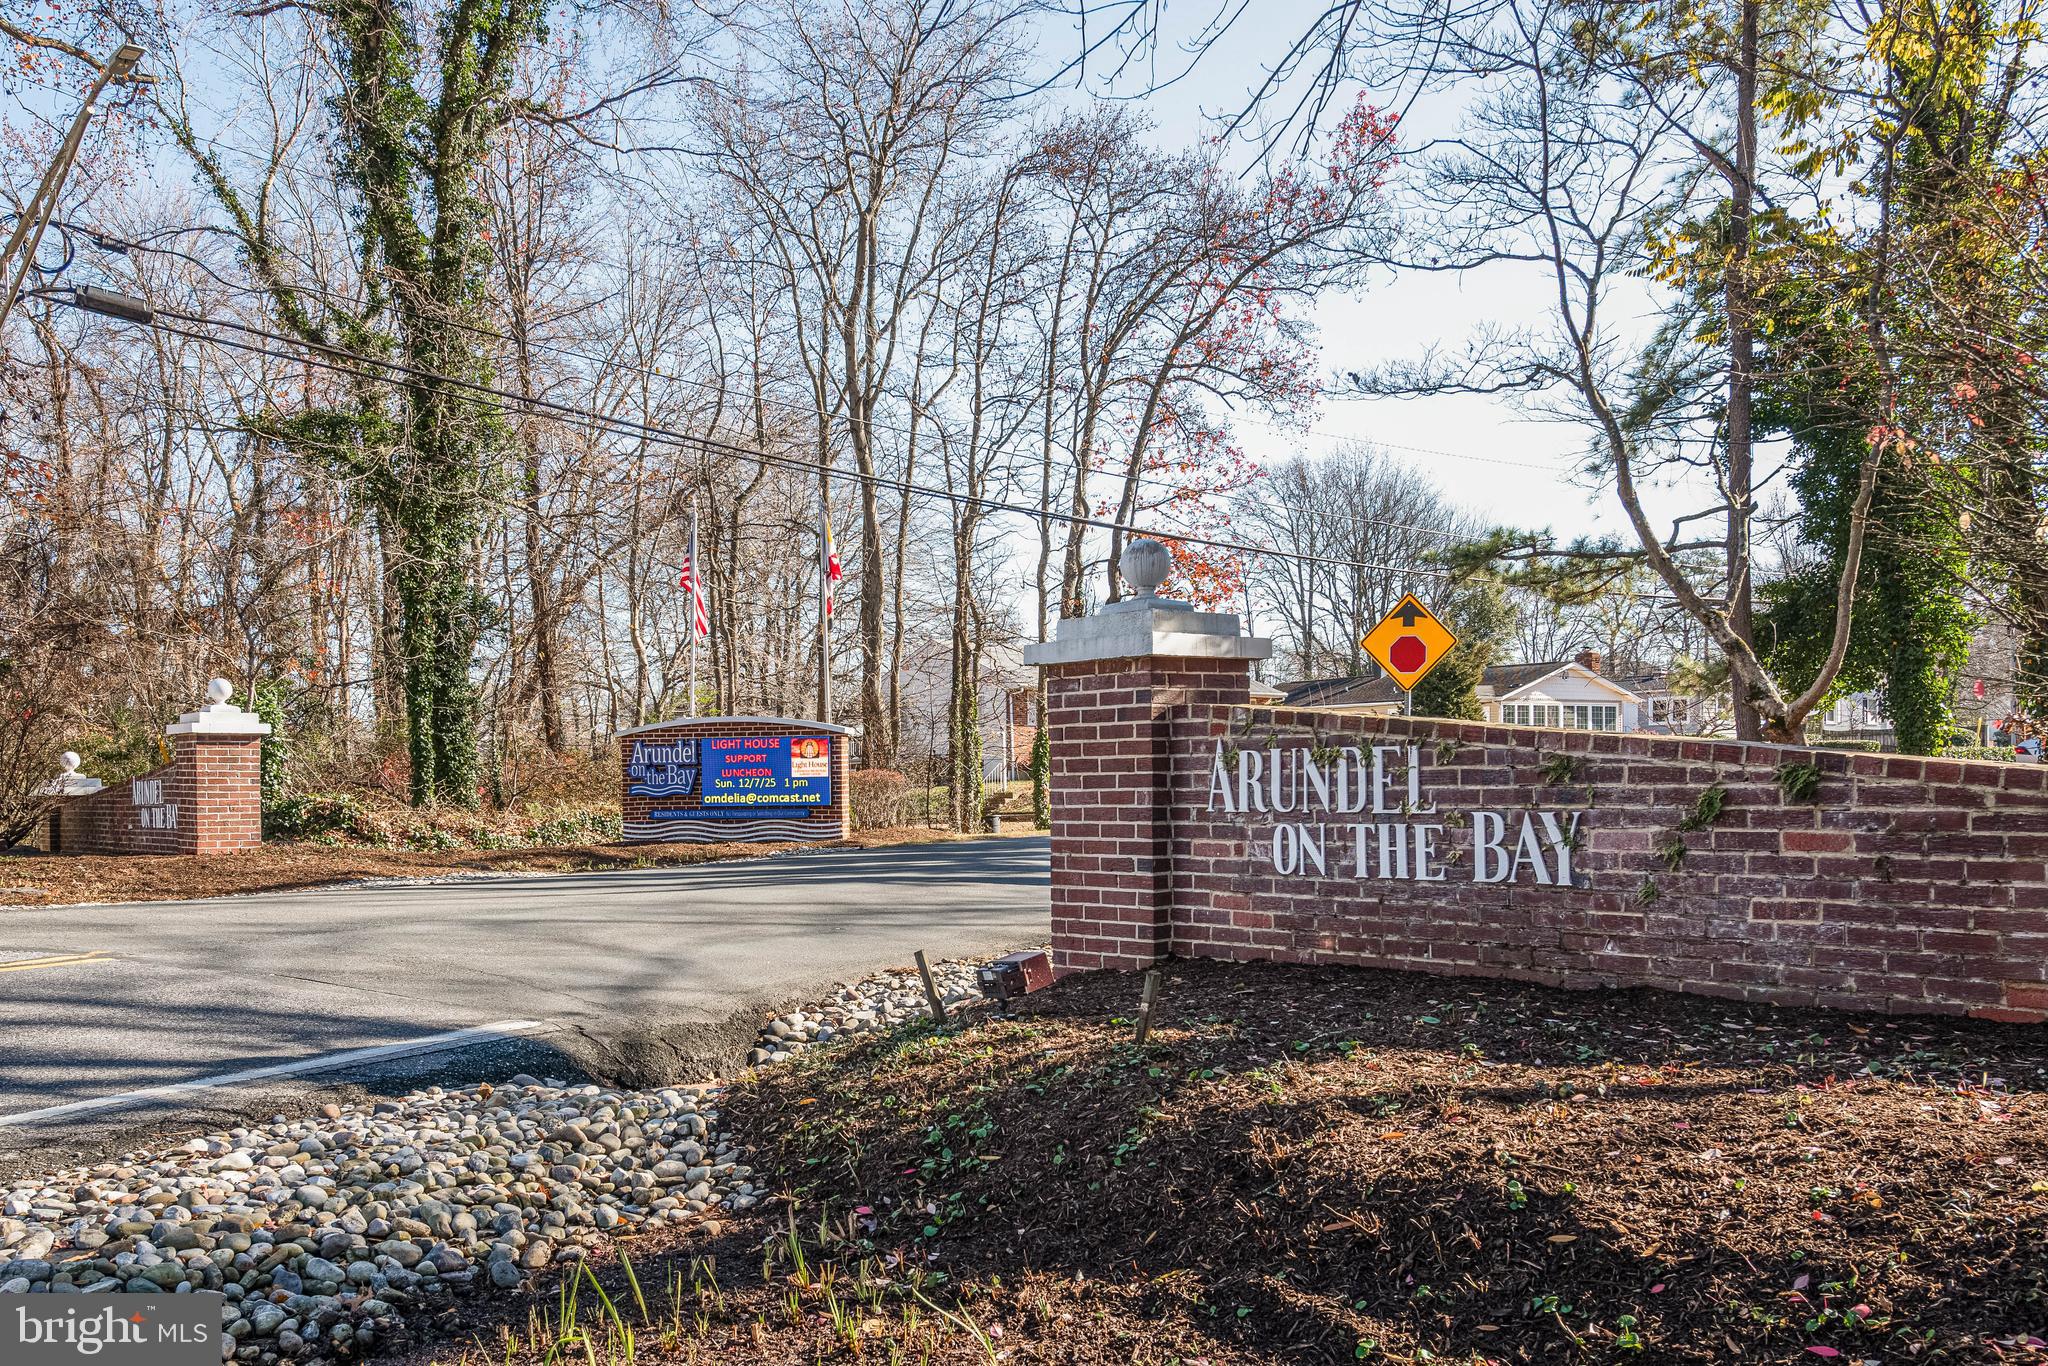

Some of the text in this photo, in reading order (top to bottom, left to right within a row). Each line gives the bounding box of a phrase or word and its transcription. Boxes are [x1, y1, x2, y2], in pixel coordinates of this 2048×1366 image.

[631, 740, 697, 764] Arundel
[711, 738, 780, 750] LIGHT HOUSE
[725, 754, 767, 763] SUPPORT
[631, 764, 696, 794] on the Bay
[721, 768, 772, 777] LUNCHEON
[1206, 736, 1437, 815] ARUNDEL
[715, 777, 808, 789] Sun. 12/7/25 1 pm
[704, 792, 821, 804] omdelia@comcast.net
[141, 808, 150, 828] ON
[151, 807, 165, 829] THE
[1272, 811, 1582, 886] ON THE BAY
